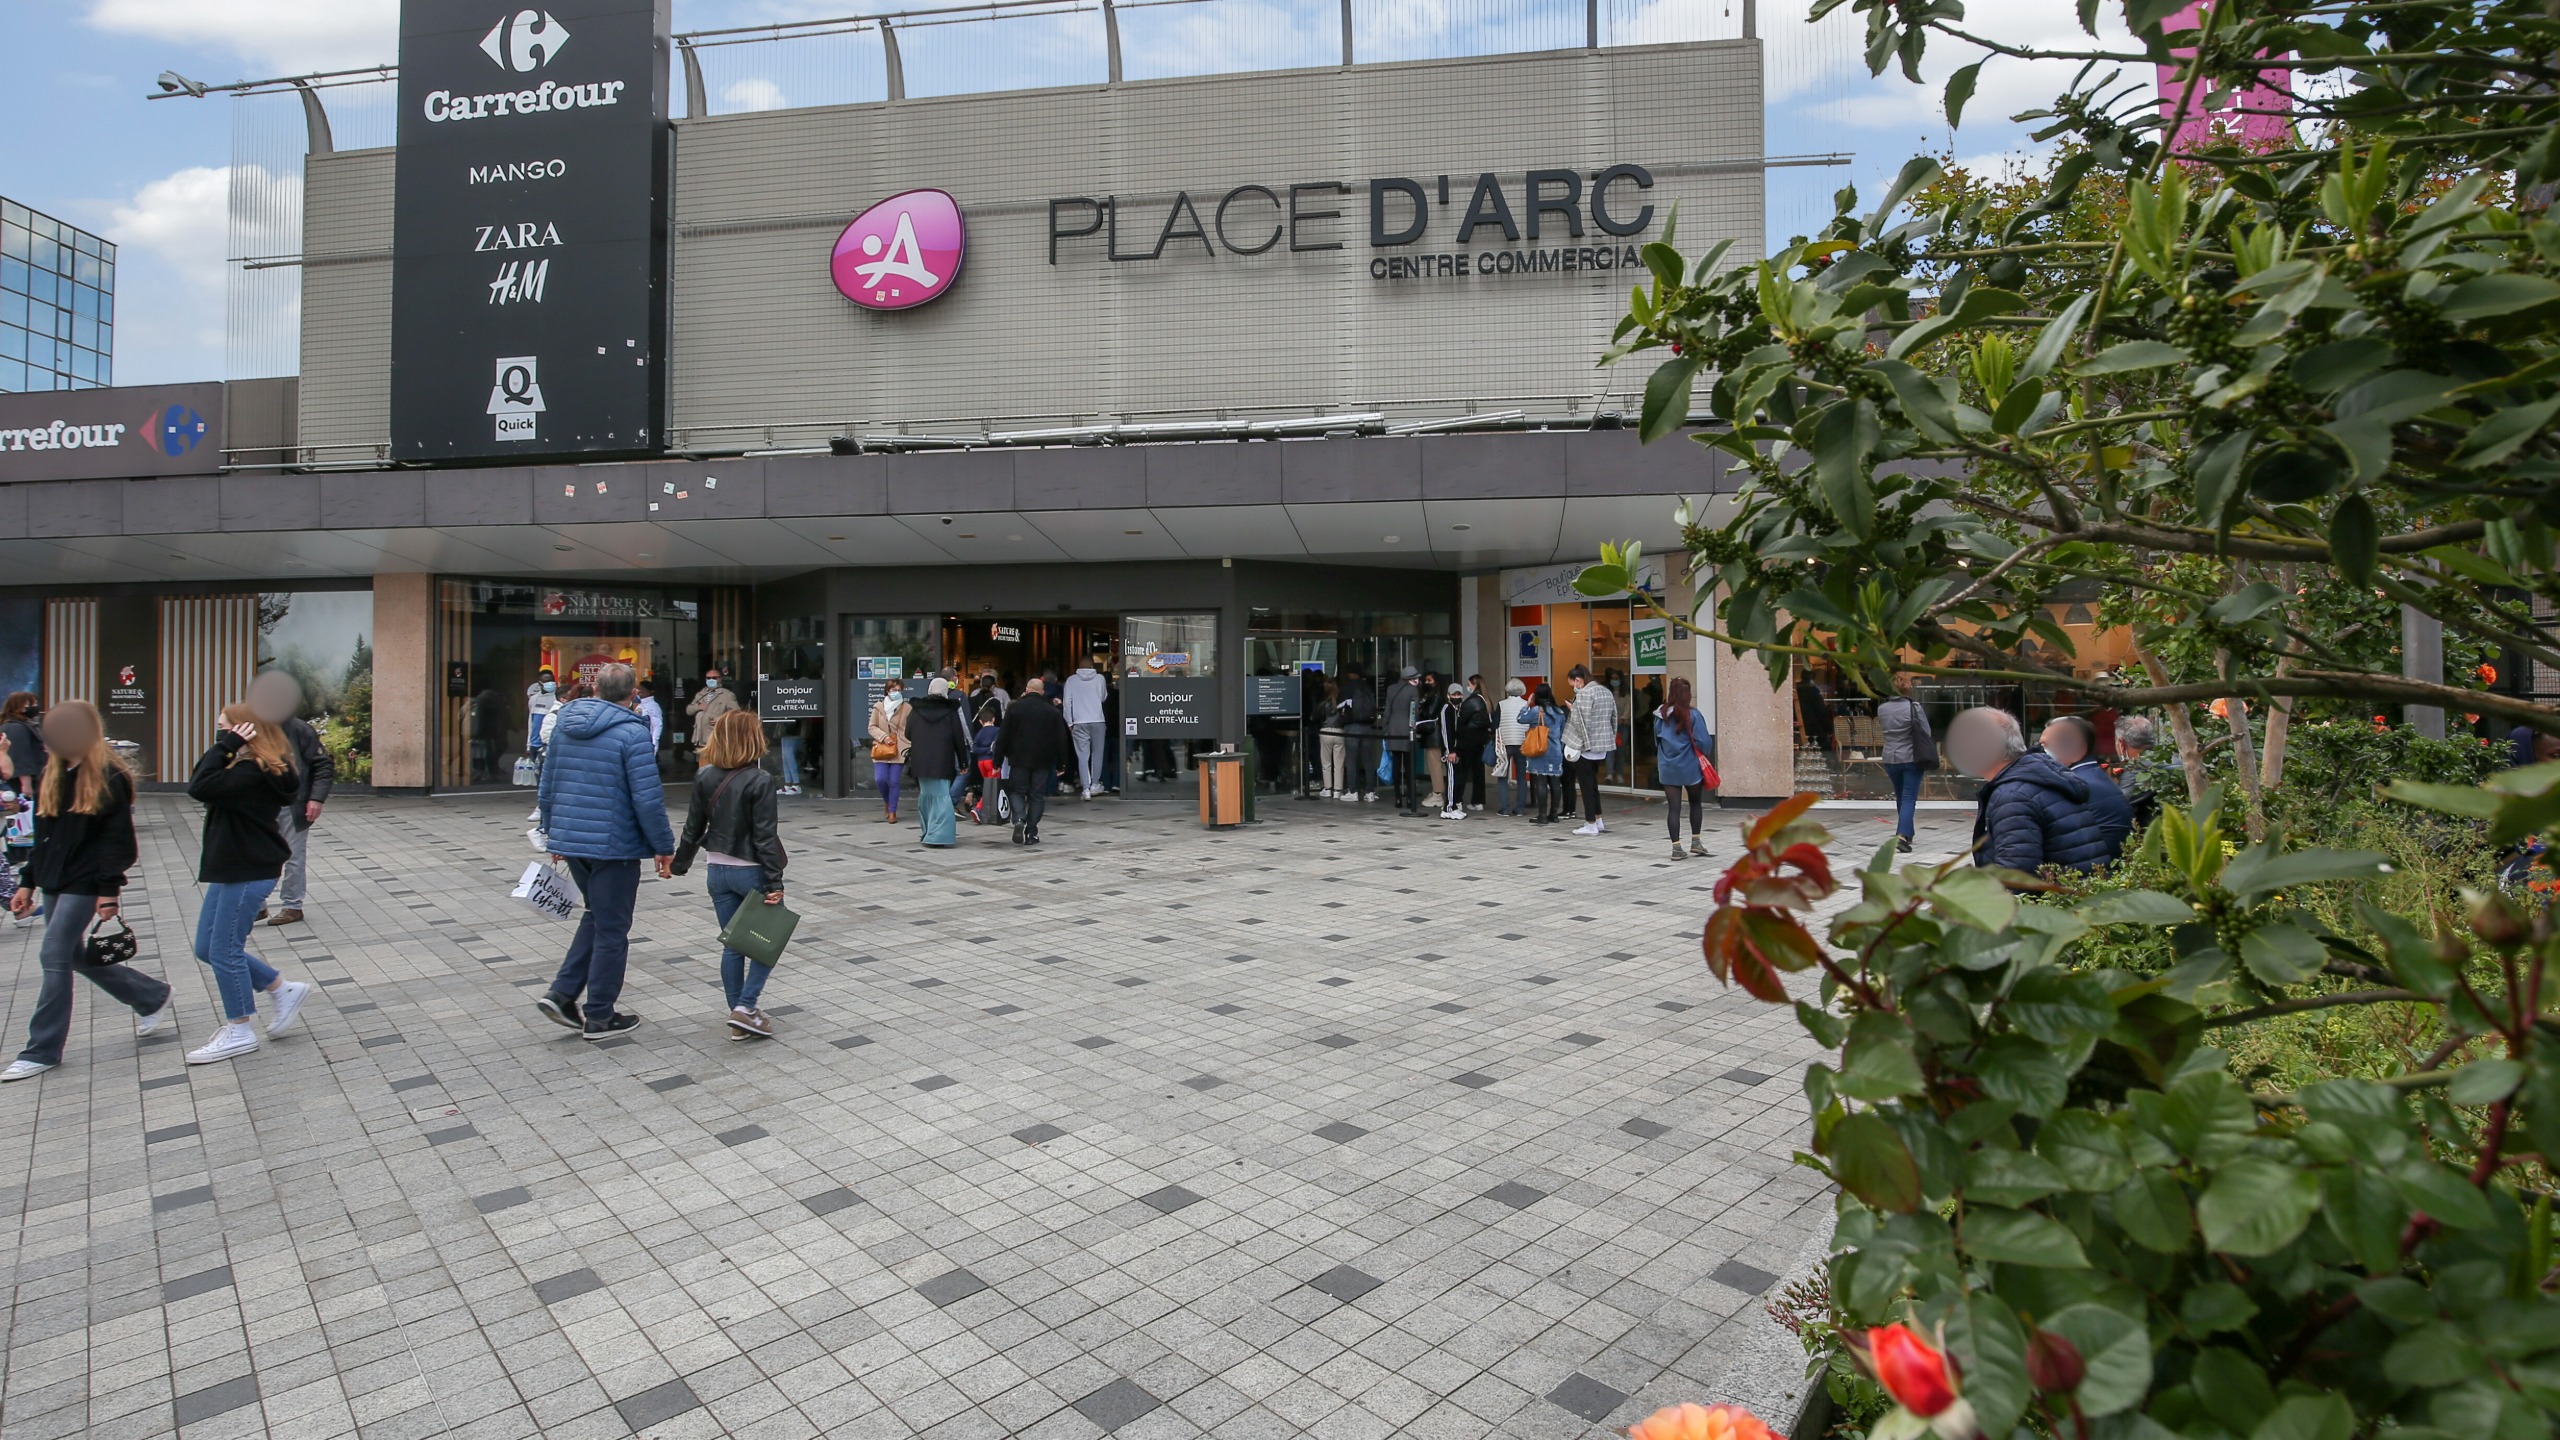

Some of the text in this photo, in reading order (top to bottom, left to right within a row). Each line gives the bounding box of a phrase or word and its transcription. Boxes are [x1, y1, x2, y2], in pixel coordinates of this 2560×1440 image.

[424, 79, 625, 123] Carrefour
[470, 158, 566, 185] MANGO
[1049, 163, 1655, 265] PLACE D'ARC
[474, 221, 564, 252] ZARA
[1369, 253, 1469, 279] CENTRE
[489, 258, 549, 306] H&M
[501, 365, 534, 406] Q
[498, 418, 535, 432] Quick
[569, 596, 634, 607] NATURE
[776, 686, 813, 696] bonjour
[1149, 692, 1193, 704] bonjour
